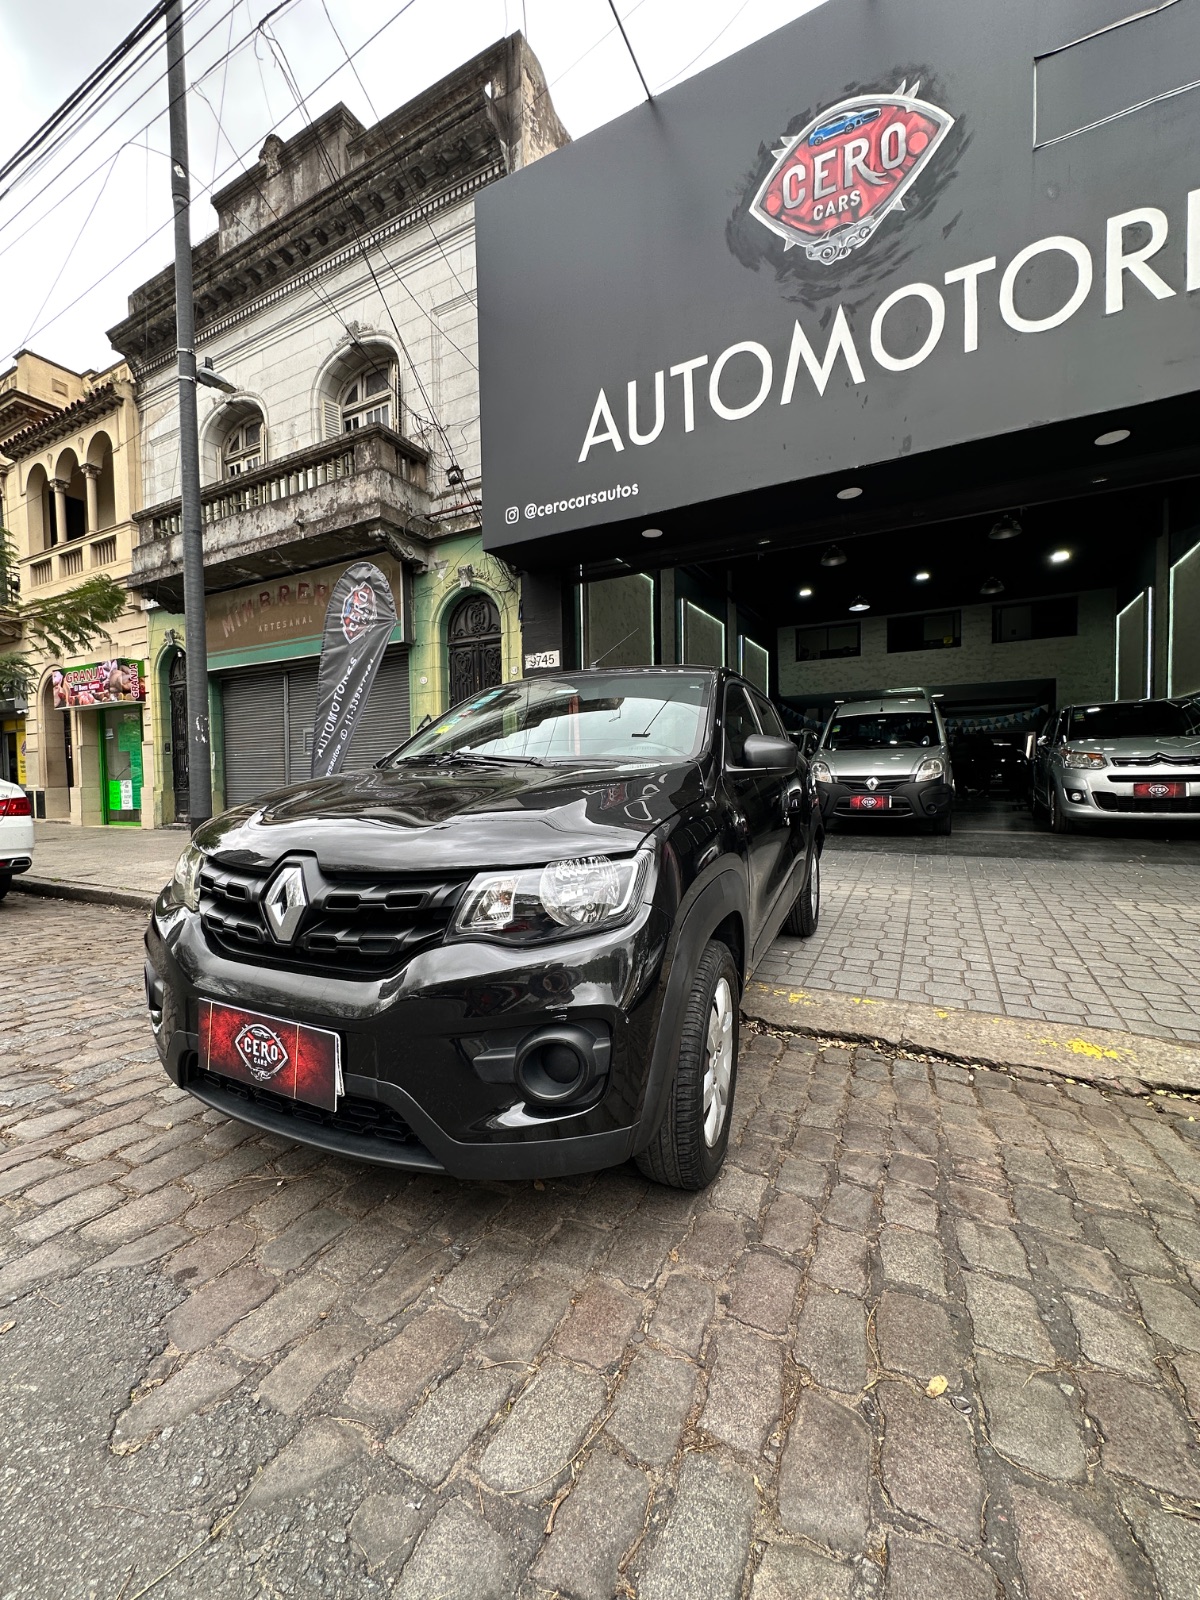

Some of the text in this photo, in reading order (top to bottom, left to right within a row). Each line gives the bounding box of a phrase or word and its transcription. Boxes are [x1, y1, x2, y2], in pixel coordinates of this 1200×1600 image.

[782, 122, 907, 209] CERO
[813, 190, 861, 220] CARS
[578, 188, 1200, 463] AUTOMOTOR
[524, 483, 639, 519] @cerocarsautos
[222, 582, 335, 638] MIMBRER
[258, 616, 313, 633] ARTESANAL
[349, 591, 369, 631] CERO
[65, 665, 106, 684] GRANJA
[130, 663, 139, 699] GRANJA
[244, 1036, 278, 1064] CERO
[253, 1057, 268, 1067] CARS
